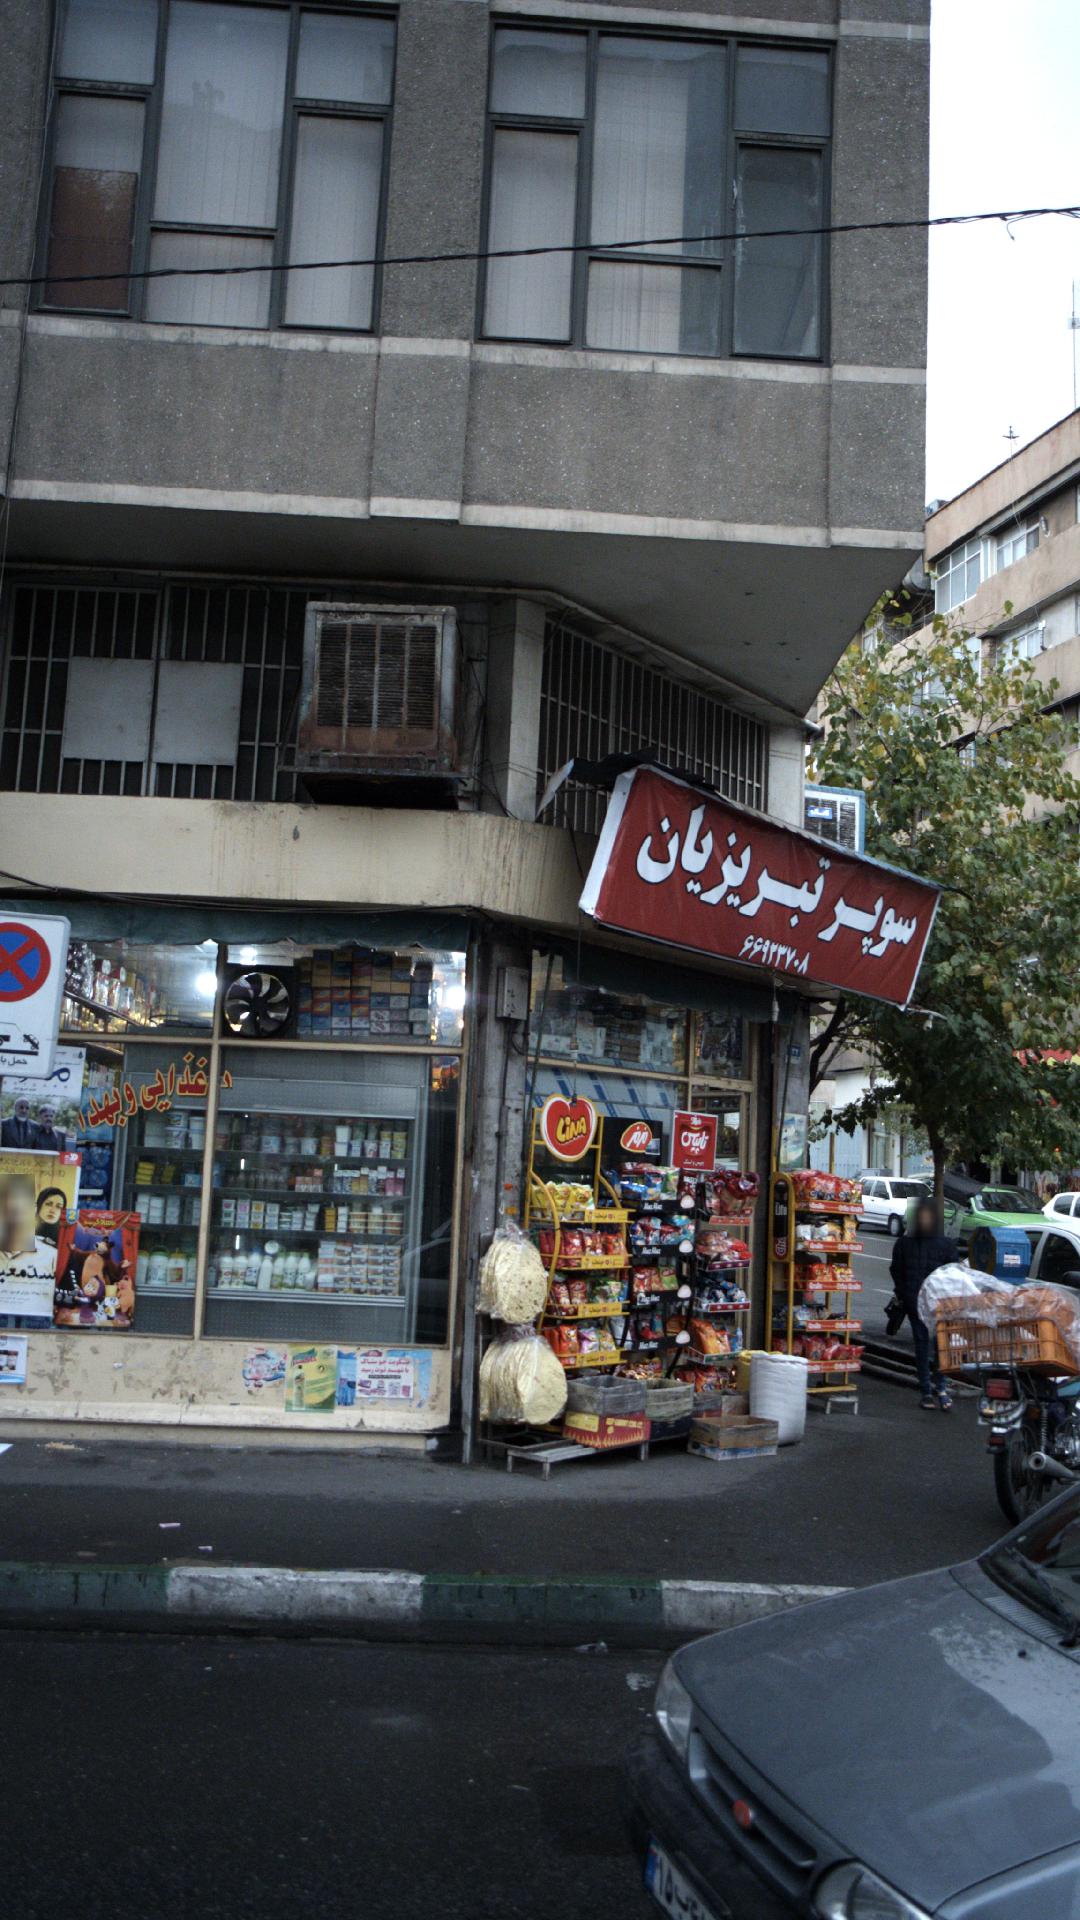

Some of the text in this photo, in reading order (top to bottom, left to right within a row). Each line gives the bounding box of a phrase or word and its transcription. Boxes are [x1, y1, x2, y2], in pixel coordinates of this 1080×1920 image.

[635, 803, 917, 957] سوپر تبریزیان
[124, 1081, 138, 1116] و
